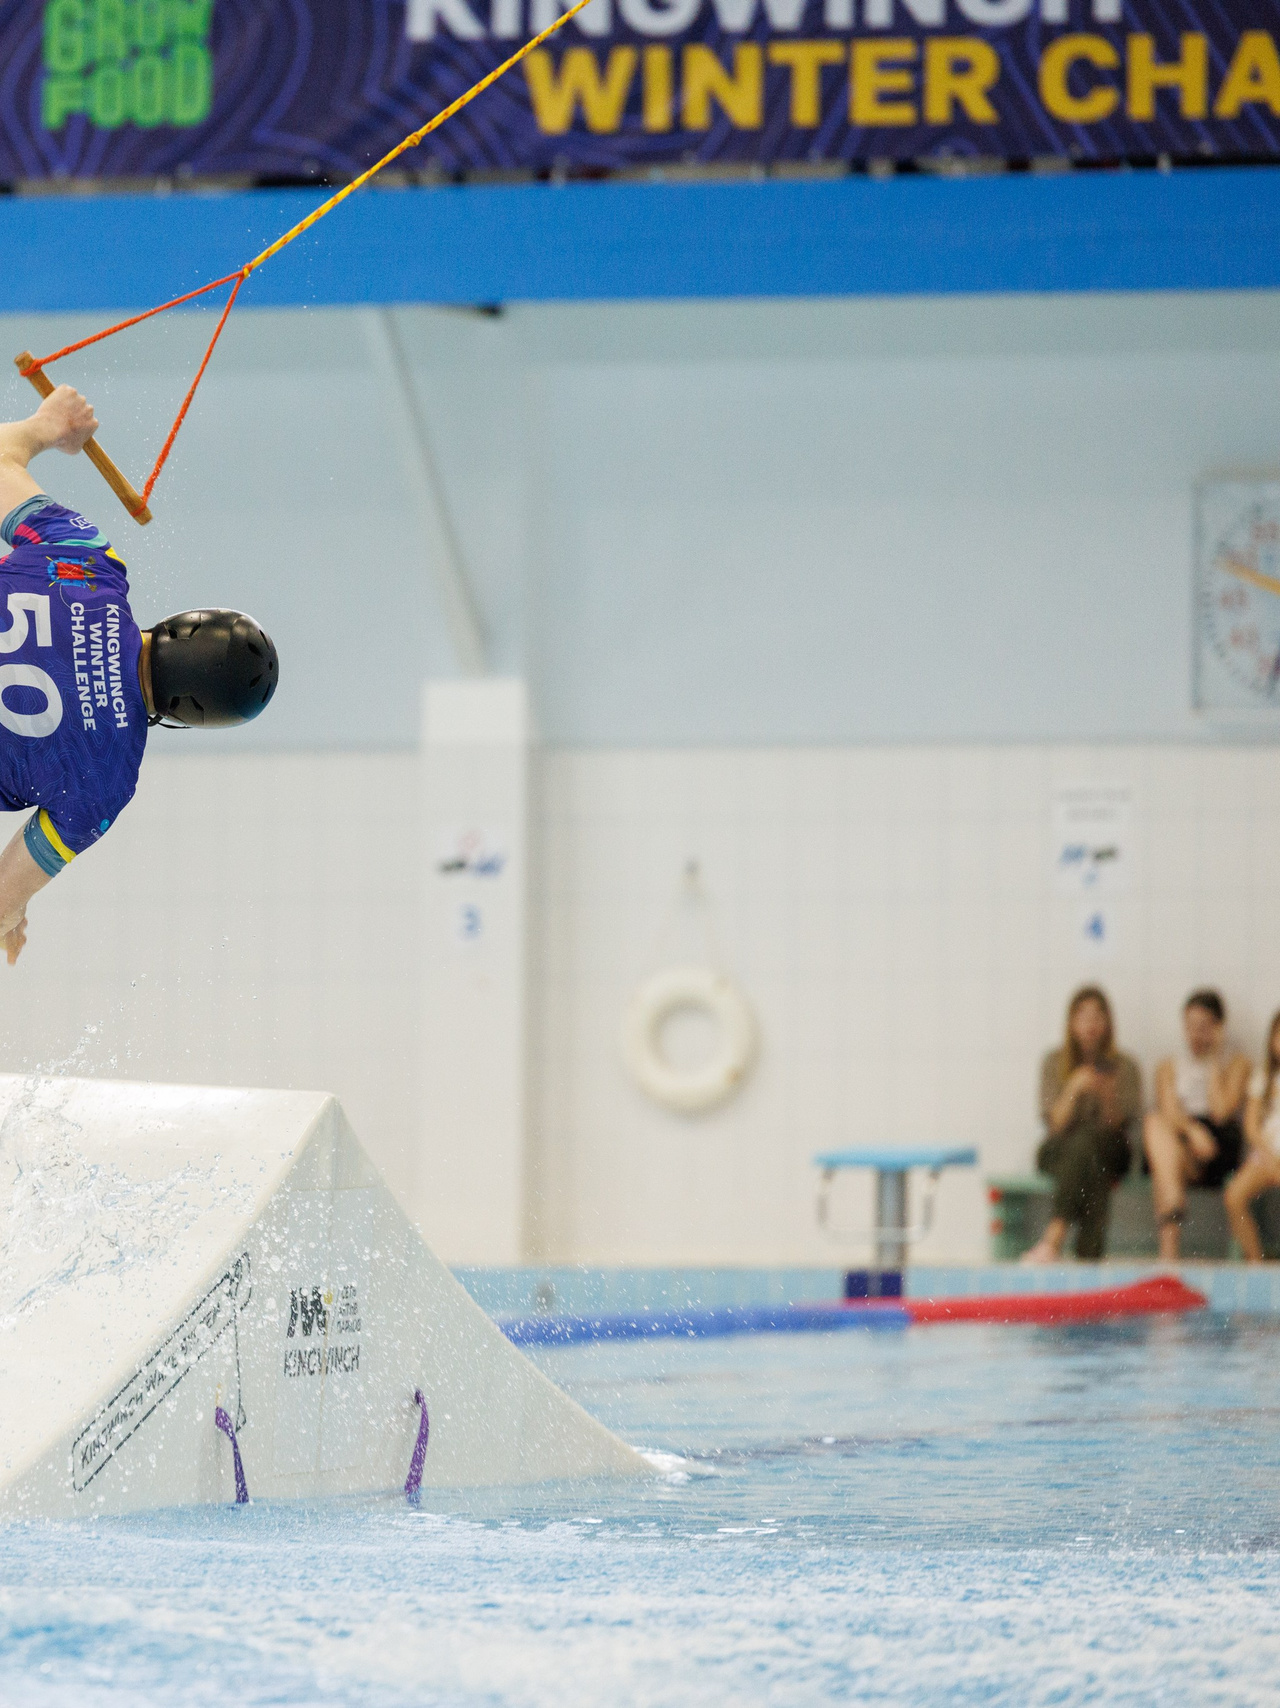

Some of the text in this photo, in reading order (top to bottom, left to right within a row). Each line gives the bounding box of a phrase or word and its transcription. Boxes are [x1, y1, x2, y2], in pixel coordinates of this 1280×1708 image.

[43, 46, 213, 129] FOOD
[522, 38, 1001, 134] WINTER
[70, 602, 97, 731] CHALLENGE
[89, 621, 109, 708] WINTER
[106, 603, 129, 729] KINGWINCH
